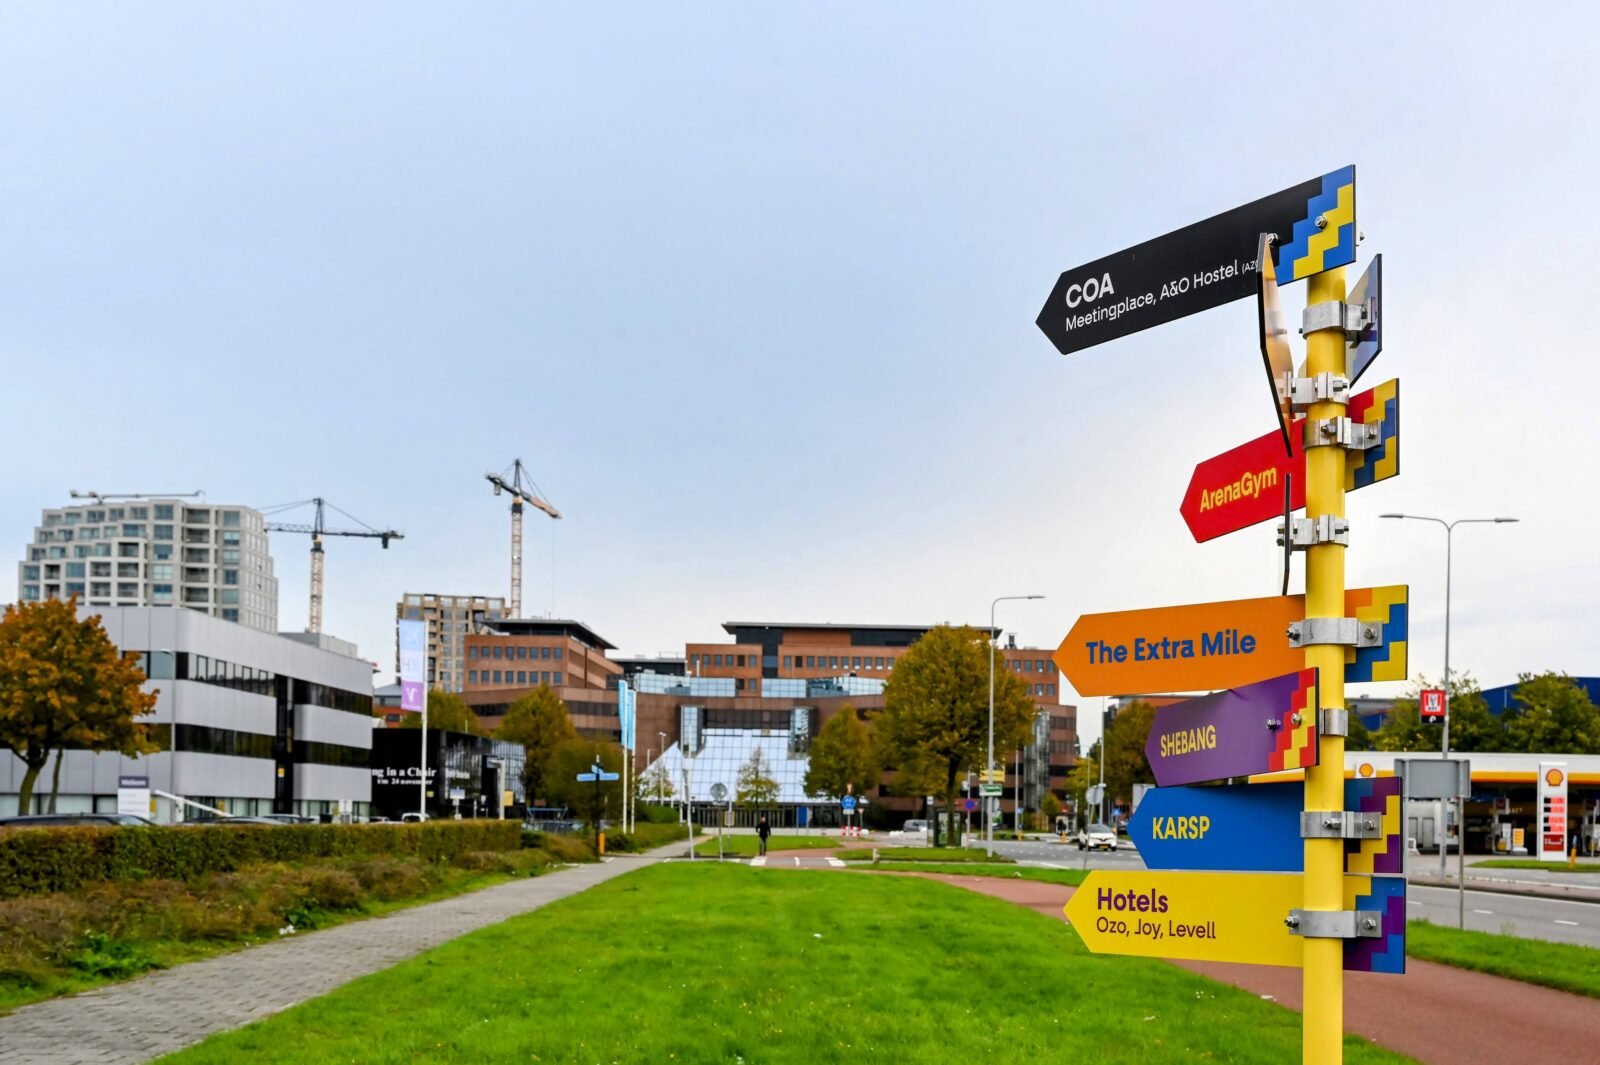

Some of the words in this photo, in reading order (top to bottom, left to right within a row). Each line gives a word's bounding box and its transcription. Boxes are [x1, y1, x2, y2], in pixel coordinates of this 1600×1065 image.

[1065, 272, 1115, 309] COA
[1065, 292, 1157, 332] Meetingplace,
[1160, 280, 1190, 301] A&O
[1193, 262, 1239, 289] Hostel
[1199, 466, 1277, 513] ArenaGym
[1086, 639, 1127, 665] The
[1134, 637, 1194, 662] Extra
[1201, 629, 1256, 658] Mile
[1160, 725, 1217, 758] SHEBANG
[386, 767, 397, 777] in
[407, 767, 437, 777] Chir
[1152, 816, 1211, 840] KARSP
[1097, 887, 1169, 914] Hotels
[1096, 916, 1130, 938] Ozo,
[1134, 918, 1164, 940] Joy,
[1168, 919, 1217, 940] Levell
